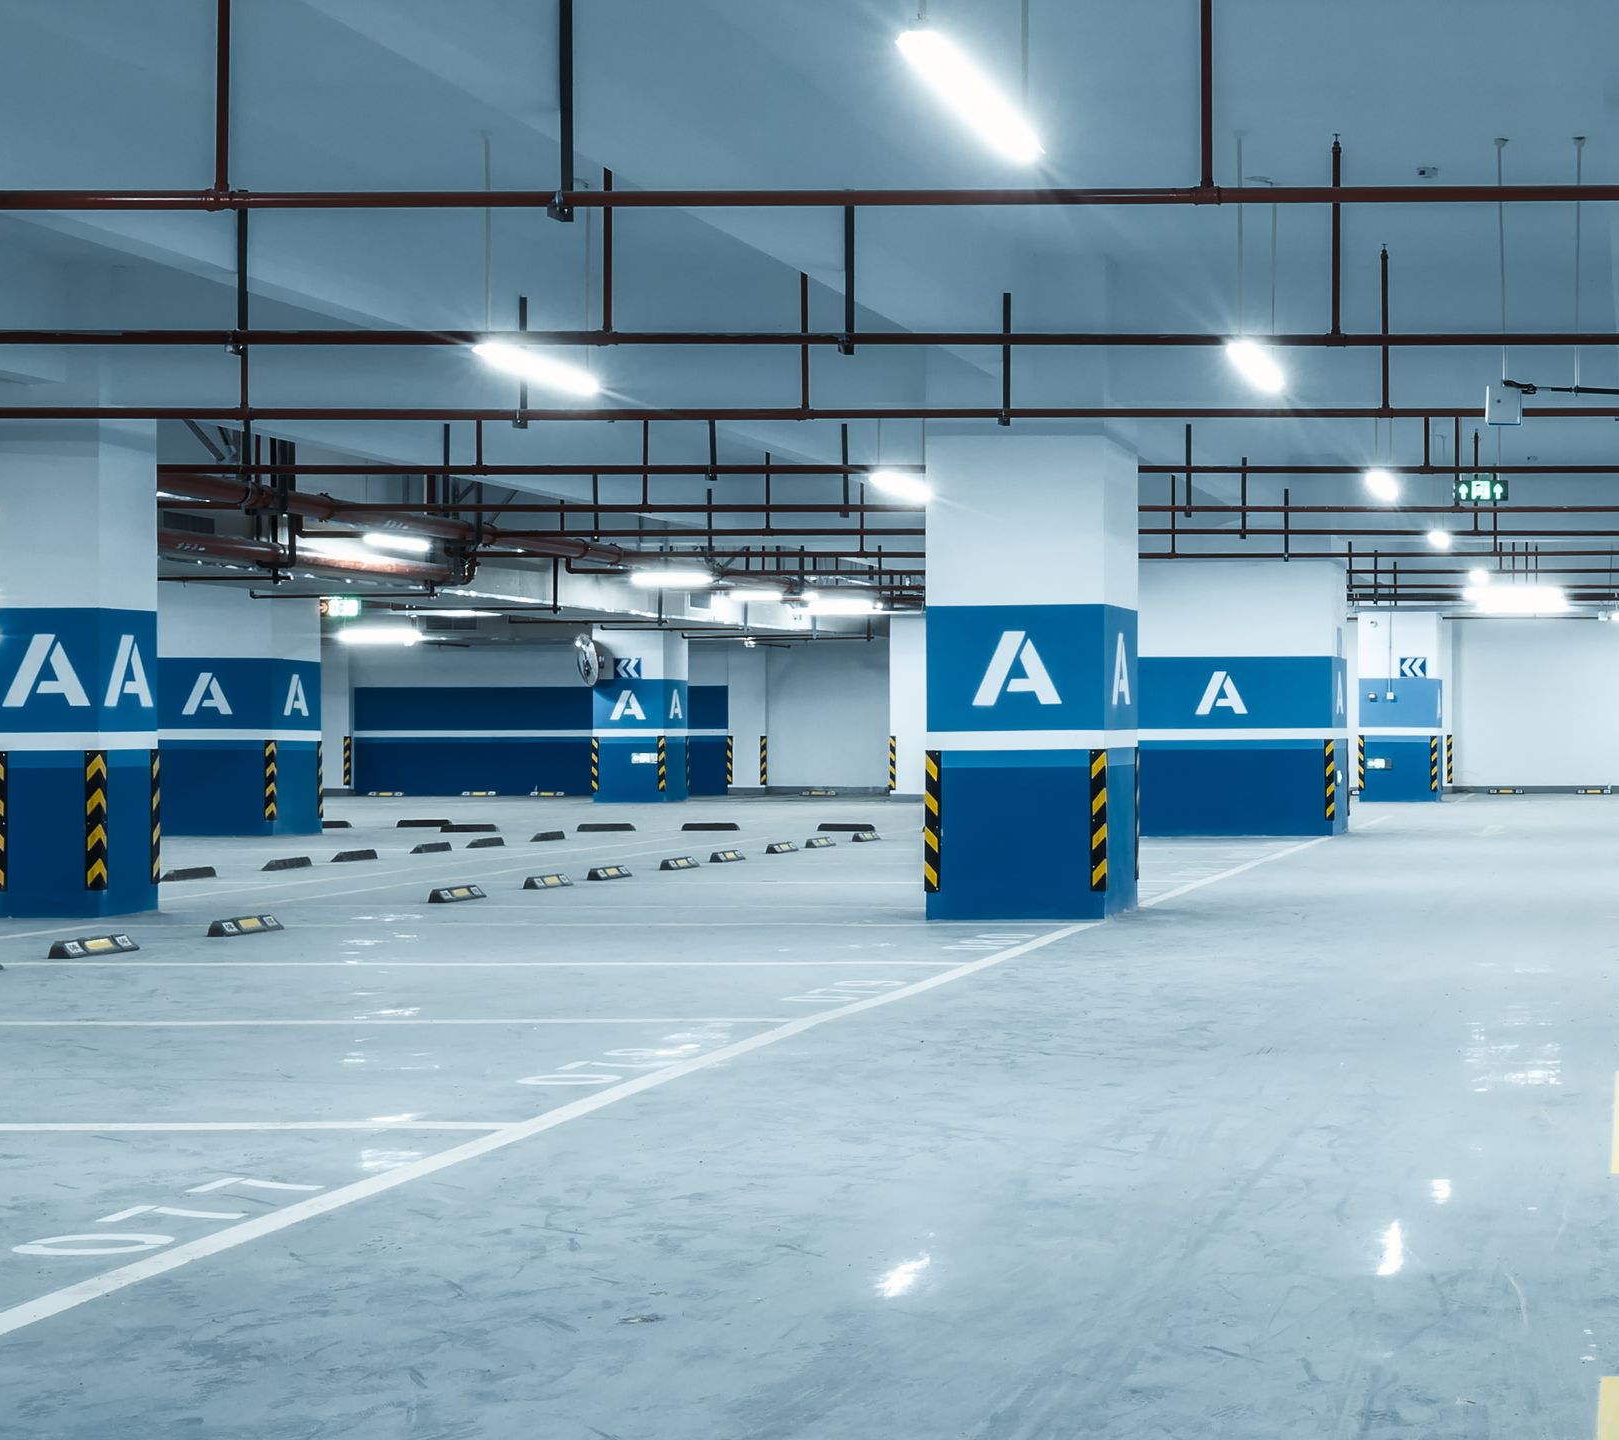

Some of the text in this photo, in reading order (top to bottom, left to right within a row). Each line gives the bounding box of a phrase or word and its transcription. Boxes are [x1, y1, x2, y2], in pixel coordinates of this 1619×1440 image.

[1, 633, 92, 707] A
[103, 634, 154, 707] A
[181, 672, 233, 715] A
[283, 674, 309, 716] A
[972, 631, 1062, 706] A
[1111, 633, 1131, 705] A
[1195, 671, 1248, 715] A
[609, 690, 647, 720] A
[669, 689, 683, 719] A
[11, 1176, 327, 1256] 077
